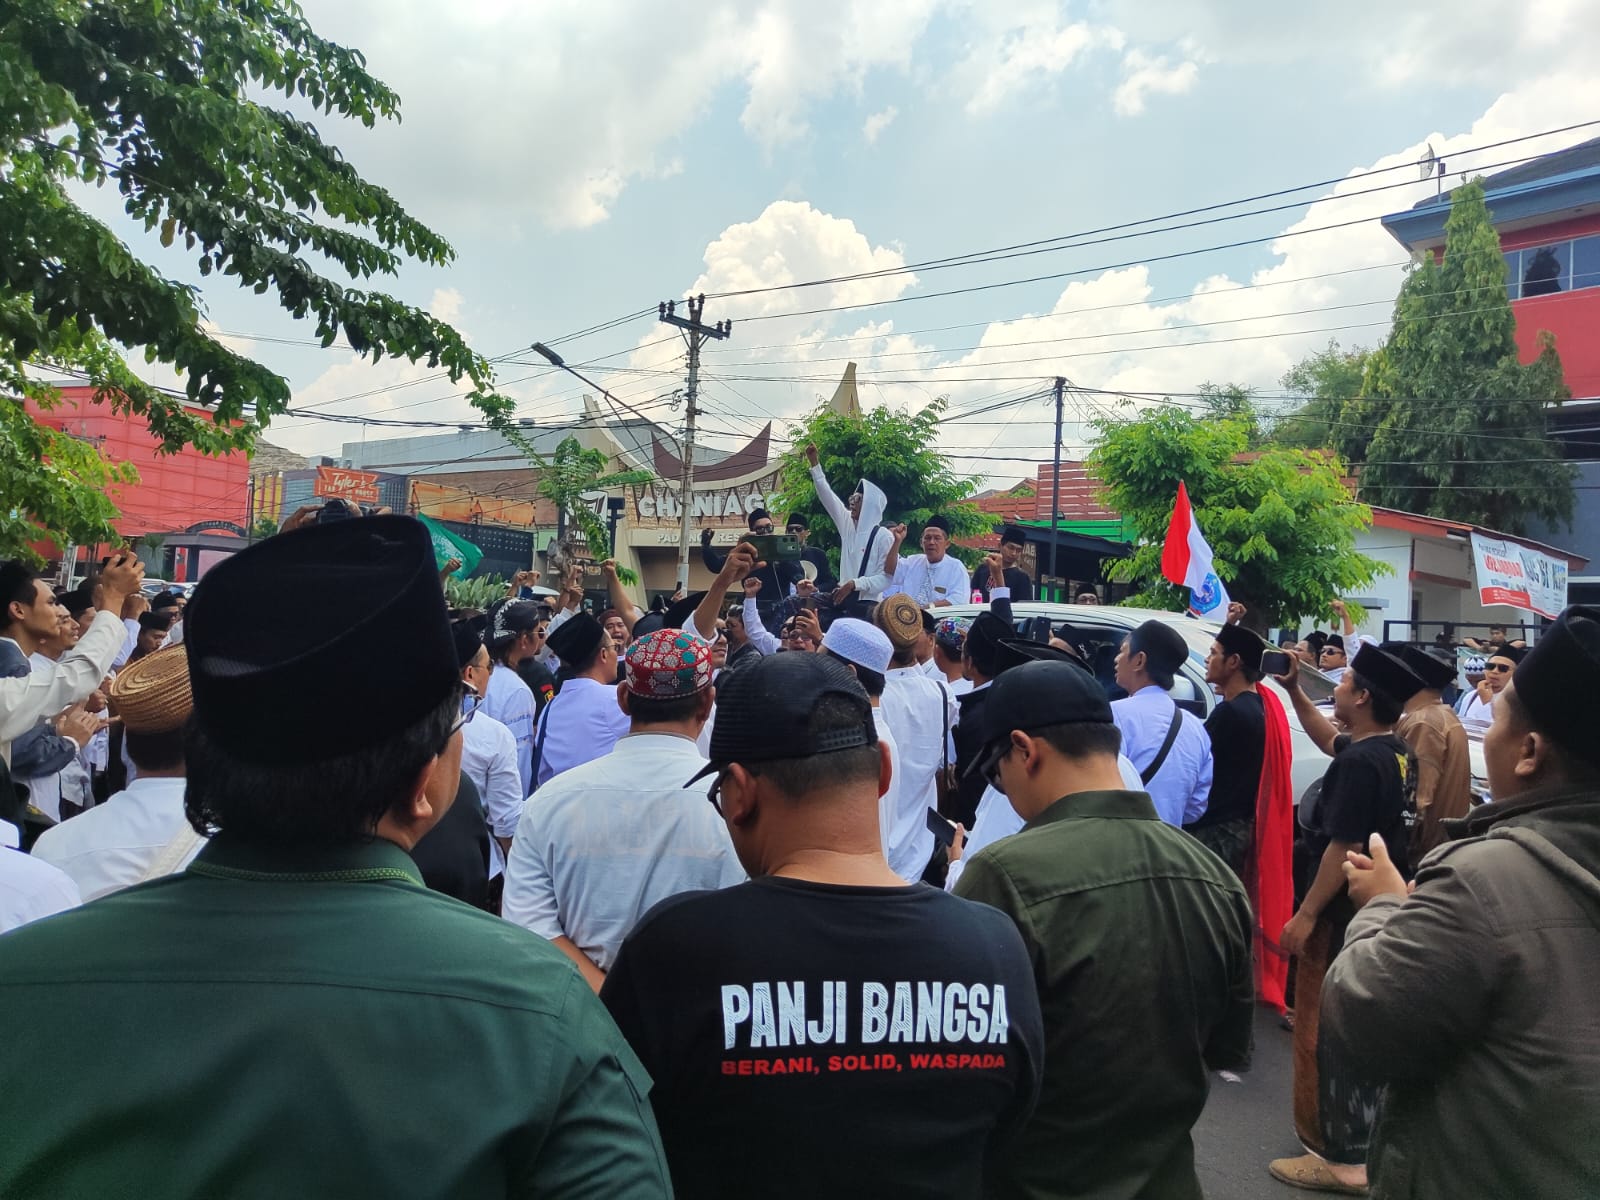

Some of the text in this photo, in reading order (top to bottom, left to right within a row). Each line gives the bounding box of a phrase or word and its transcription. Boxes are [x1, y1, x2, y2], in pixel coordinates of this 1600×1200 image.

[721, 981, 1009, 1050] PANJI BANGSA
[721, 1054, 1006, 1075] BERANI, SOLID, WASPADA
